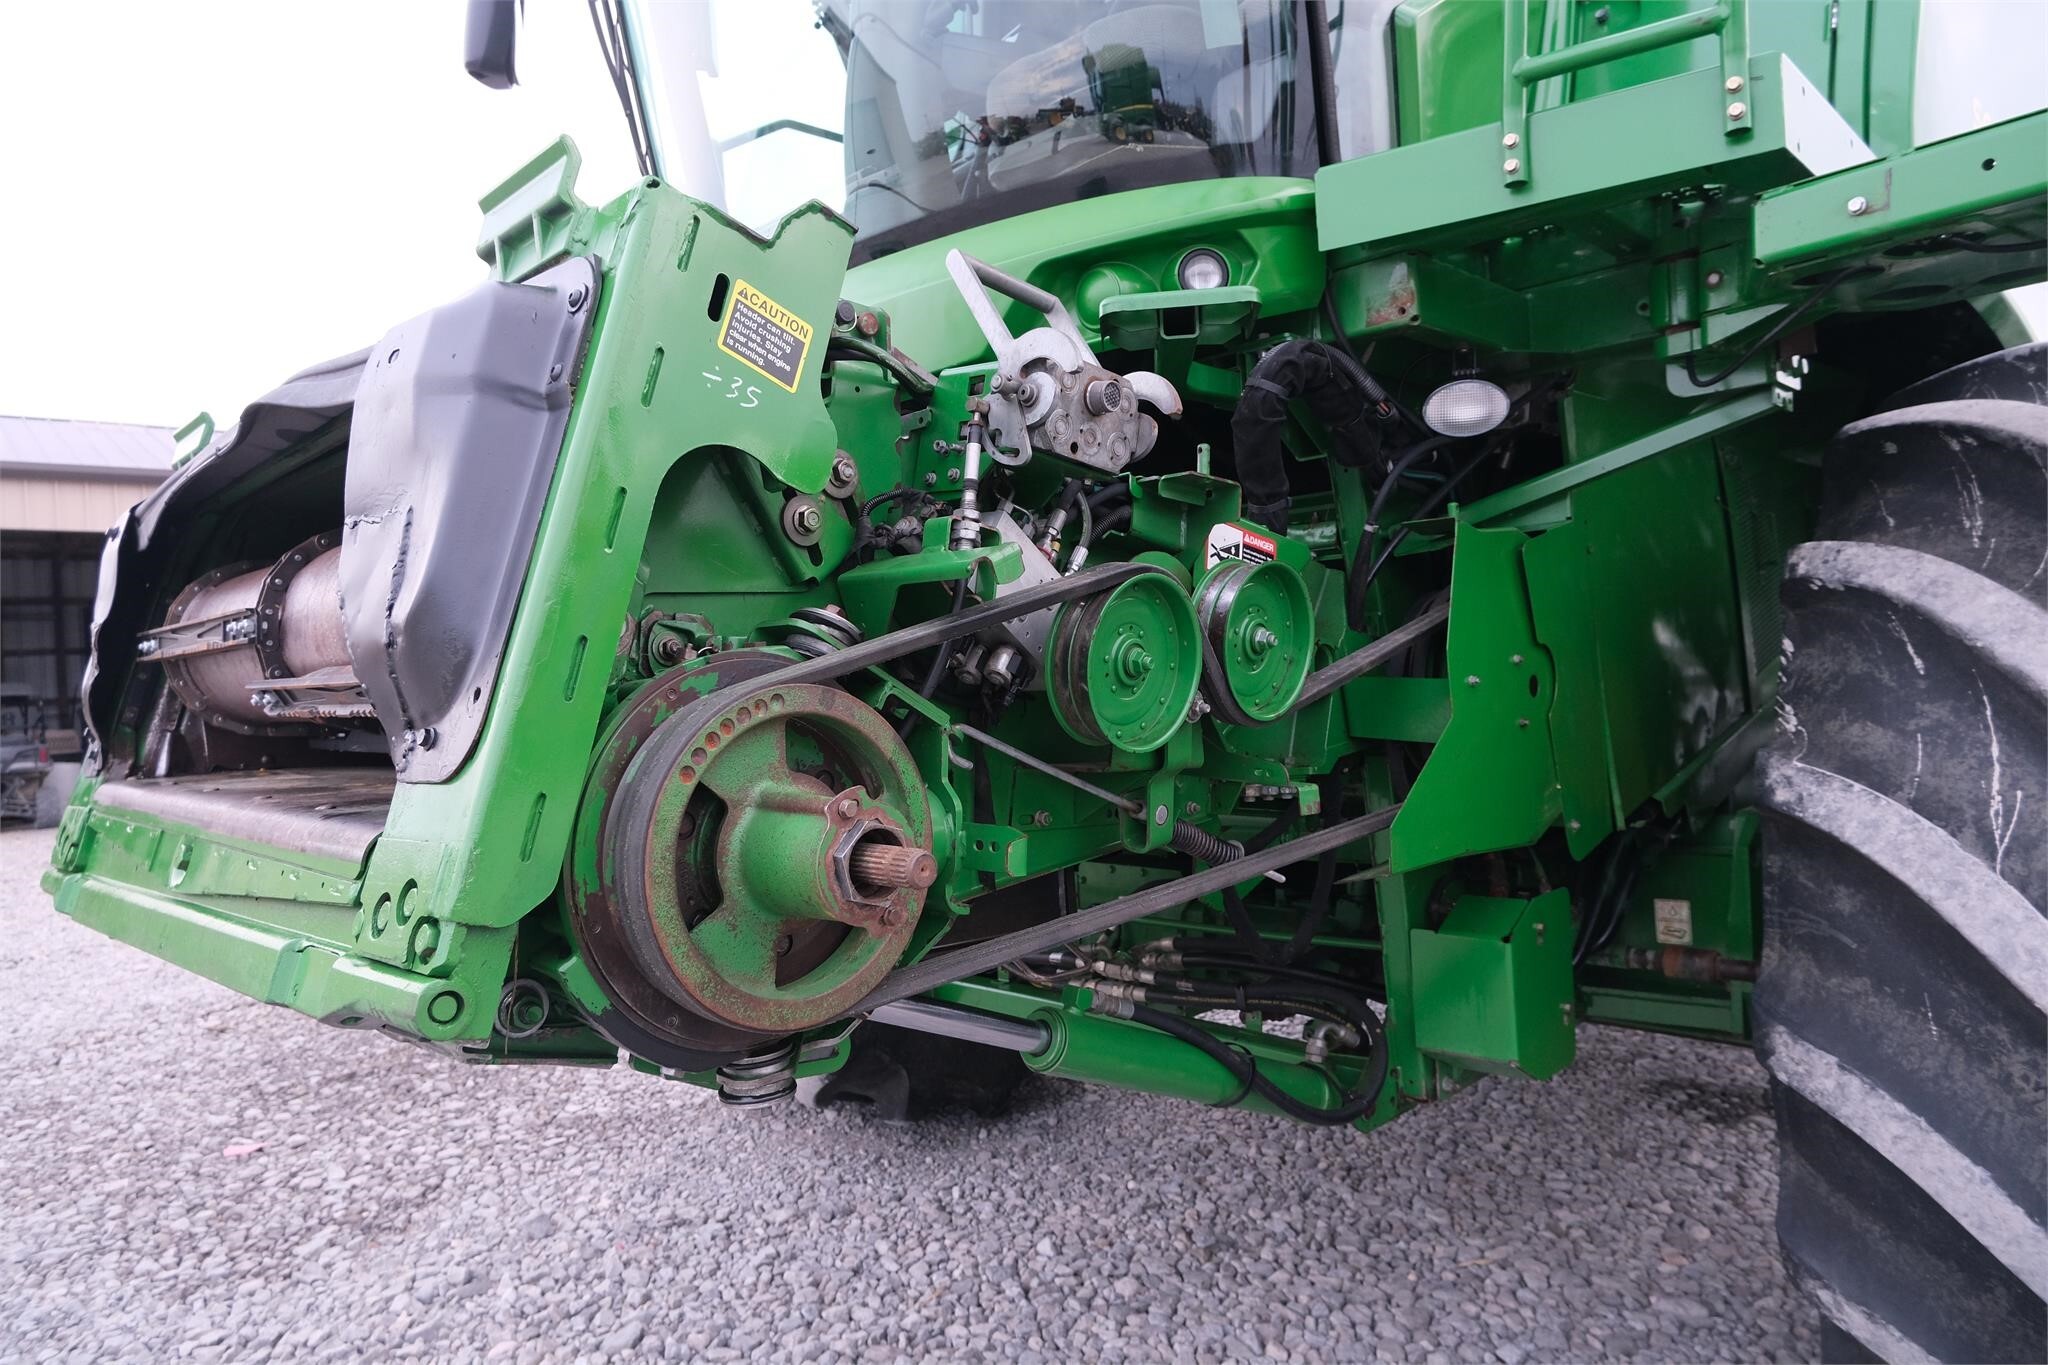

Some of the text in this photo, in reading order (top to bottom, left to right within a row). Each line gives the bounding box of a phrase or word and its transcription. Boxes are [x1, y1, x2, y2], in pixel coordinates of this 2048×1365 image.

[737, 303, 765, 325] Header
[767, 323, 781, 335] can
[750, 293, 808, 339] CAUTION
[735, 312, 792, 354] Avoid crushing
[765, 339, 783, 357] Stay
[729, 329, 791, 372] clear when engine
[735, 343, 765, 366] running.
[1249, 536, 1274, 552] DANGER
